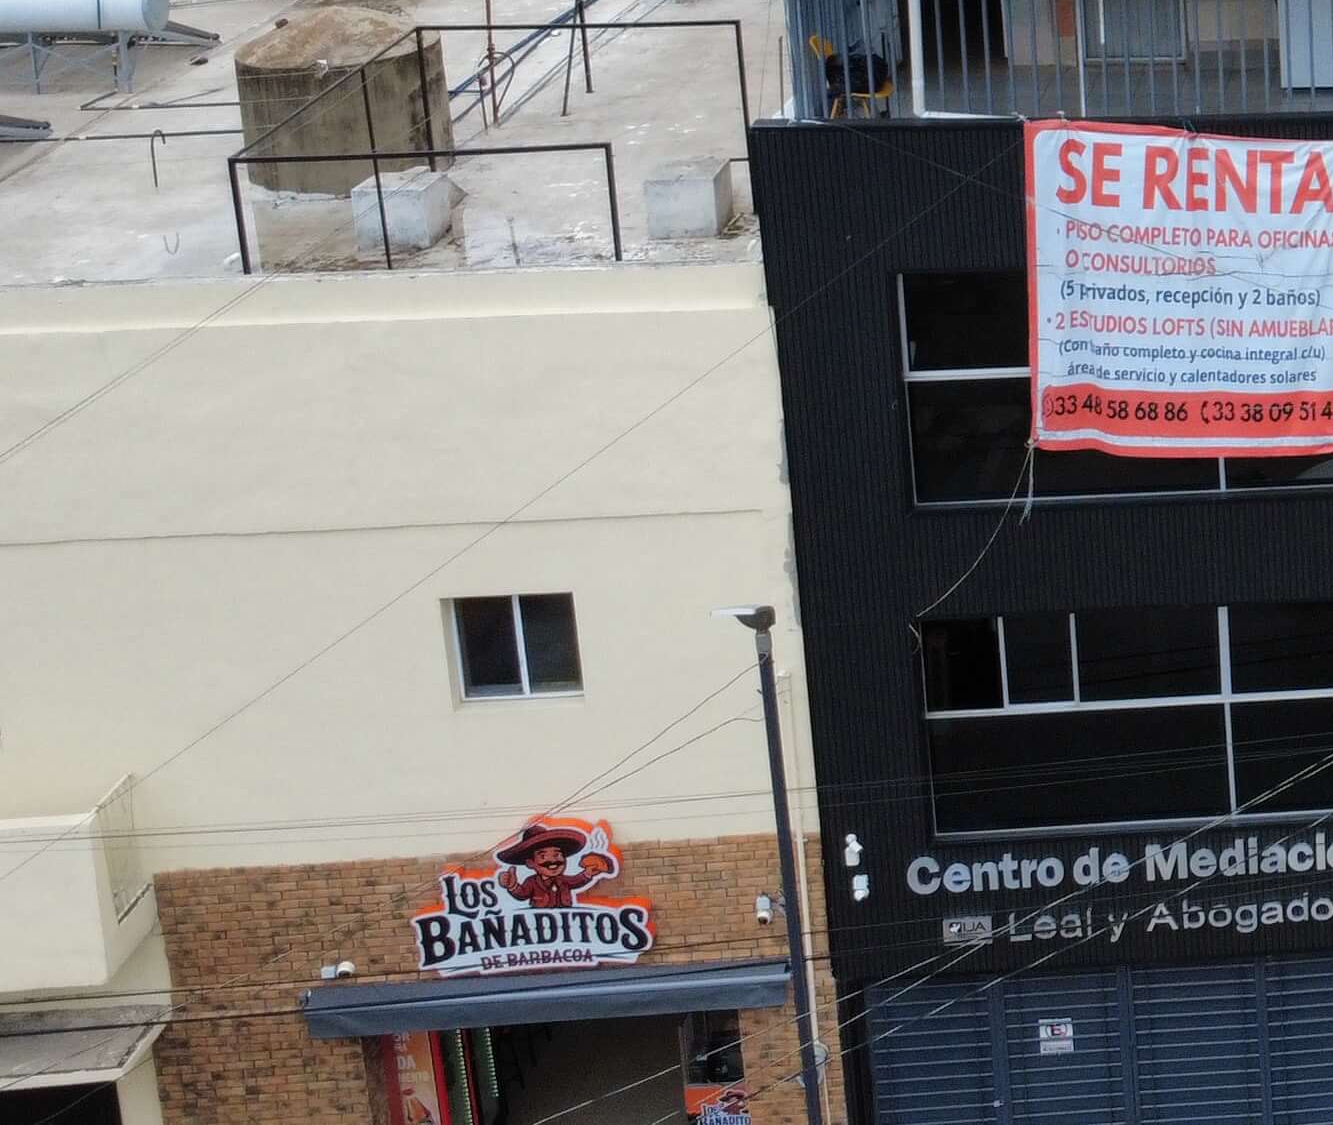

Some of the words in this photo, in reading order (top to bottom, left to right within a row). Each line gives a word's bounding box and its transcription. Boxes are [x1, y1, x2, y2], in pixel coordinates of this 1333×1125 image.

[1056, 138, 1122, 208] SE
[1066, 220, 1102, 241] PISO
[1107, 224, 1201, 246] COMPLETO
[1207, 228, 1253, 247] PARA
[1082, 252, 1216, 275] CONSULTORIOS
[1060, 280, 1074, 300] (5
[1156, 287, 1233, 308] recepción
[1238, 292, 1248, 310] y
[1252, 289, 1261, 305] 2
[1266, 288, 1320, 307] baños)
[1056, 312, 1065, 330] 2
[1070, 310, 1147, 334] ESTUDIOS
[1153, 317, 1205, 336] LOFTS
[1210, 317, 1244, 339] (SIN
[1059, 339, 1088, 355] (Con
[1123, 344, 1186, 362] completo
[1190, 349, 1197, 363] y
[1200, 346, 1242, 360] cocina
[1246, 347, 1297, 364] integral
[1301, 345, 1325, 361] c/u)
[1068, 361, 1094, 376] área
[1096, 365, 1110, 380] de
[1114, 368, 1166, 383] servicio
[1170, 372, 1177, 386] y
[1181, 368, 1266, 384] calentadores
[1270, 370, 1317, 384] solares
[1055, 395, 1077, 416] 33
[1107, 400, 1129, 420] 58
[1135, 402, 1158, 421] 68
[1165, 402, 1188, 421] 86
[1213, 402, 1235, 421] 33
[1241, 403, 1263, 423] 38
[1269, 402, 1293, 422] 09
[1300, 401, 1316, 421] 51
[906, 852, 1065, 895] Centro
[1073, 847, 1131, 886] de
[415, 907, 651, 967] BAÑADITOS
[1008, 906, 1092, 942] Leal
[1108, 912, 1129, 943] y
[481, 954, 504, 971] DE
[508, 948, 593, 967] BARBACOA
